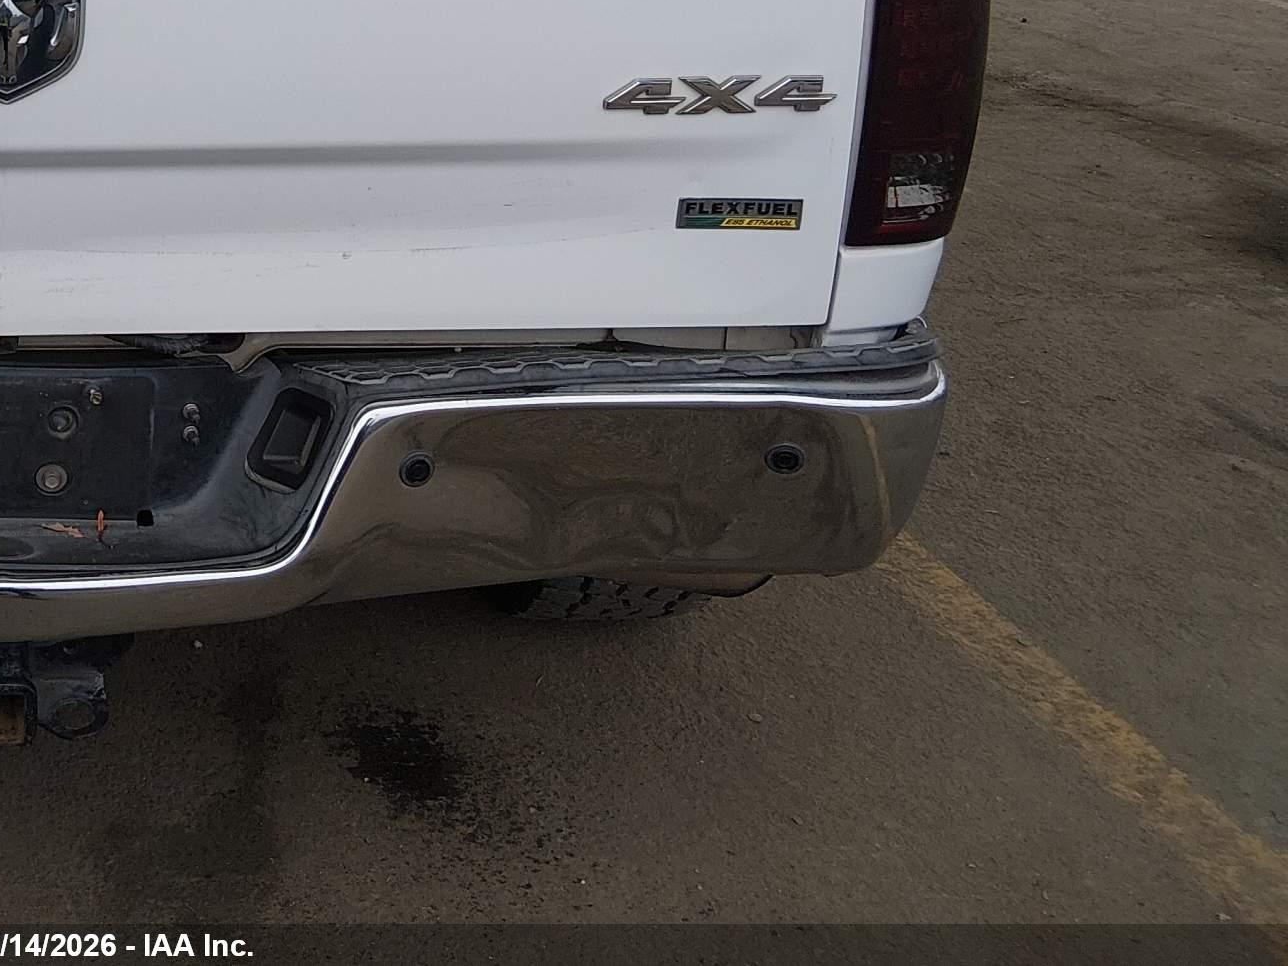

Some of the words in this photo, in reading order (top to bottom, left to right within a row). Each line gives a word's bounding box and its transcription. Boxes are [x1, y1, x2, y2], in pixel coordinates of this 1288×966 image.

[684, 200, 799, 215] FLEXFUEL
[725, 218, 745, 226] E85
[746, 218, 794, 227] ETHANOL
